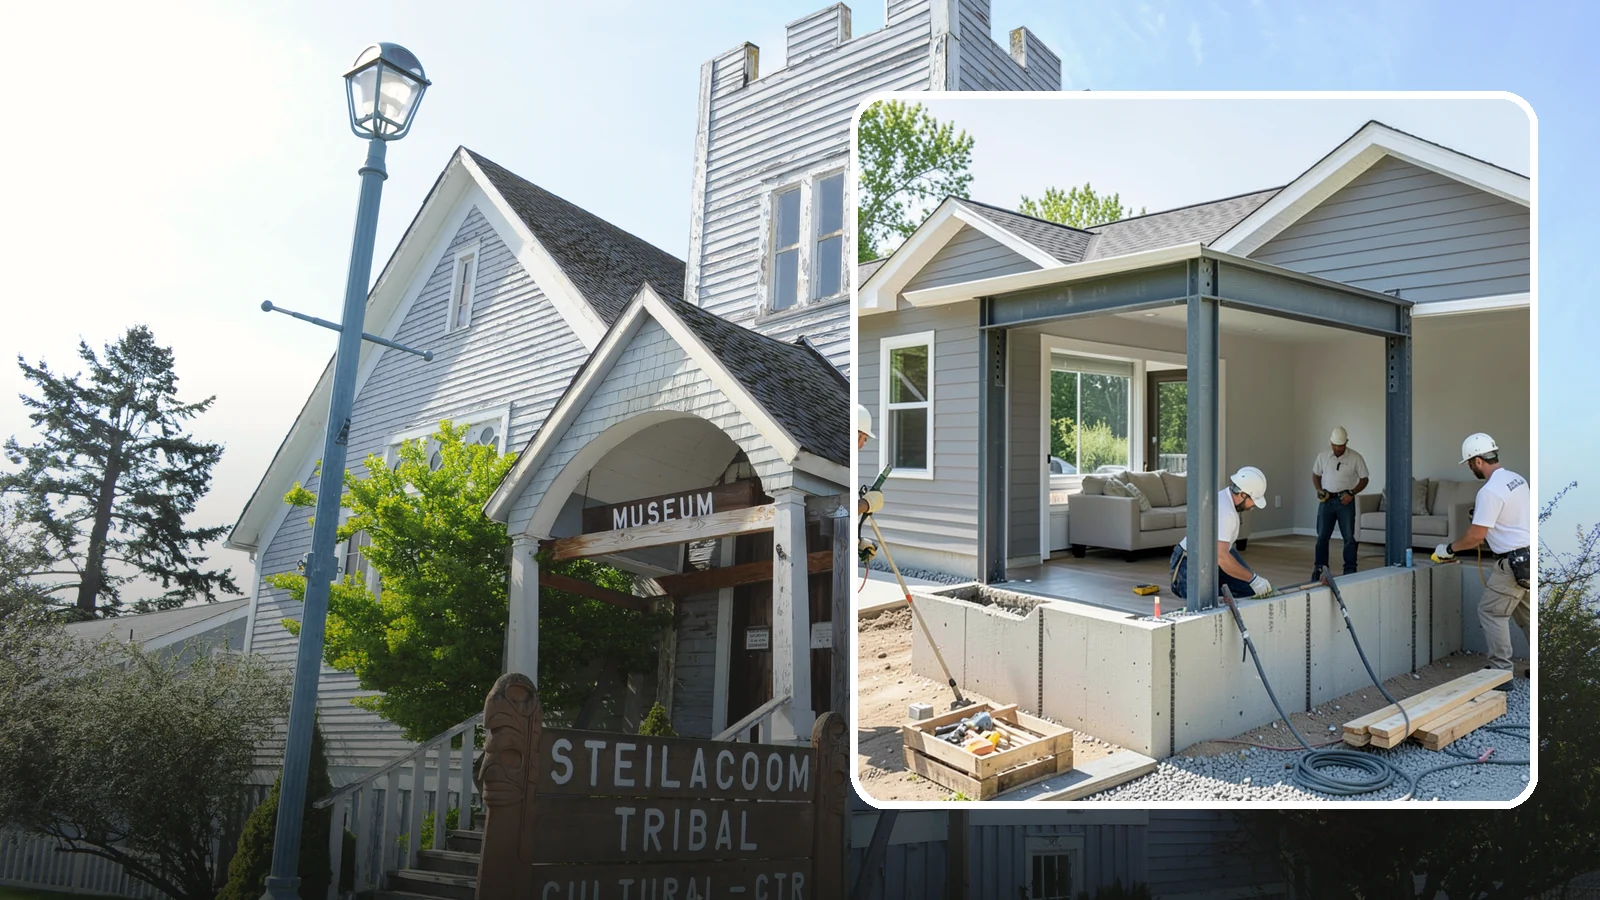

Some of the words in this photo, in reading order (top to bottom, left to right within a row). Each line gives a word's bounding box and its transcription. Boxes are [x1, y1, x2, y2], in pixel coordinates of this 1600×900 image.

[612, 492, 714, 530] MUSEUM
[550, 738, 810, 793] STEILACOOM
[614, 807, 758, 853] TRIBAL
